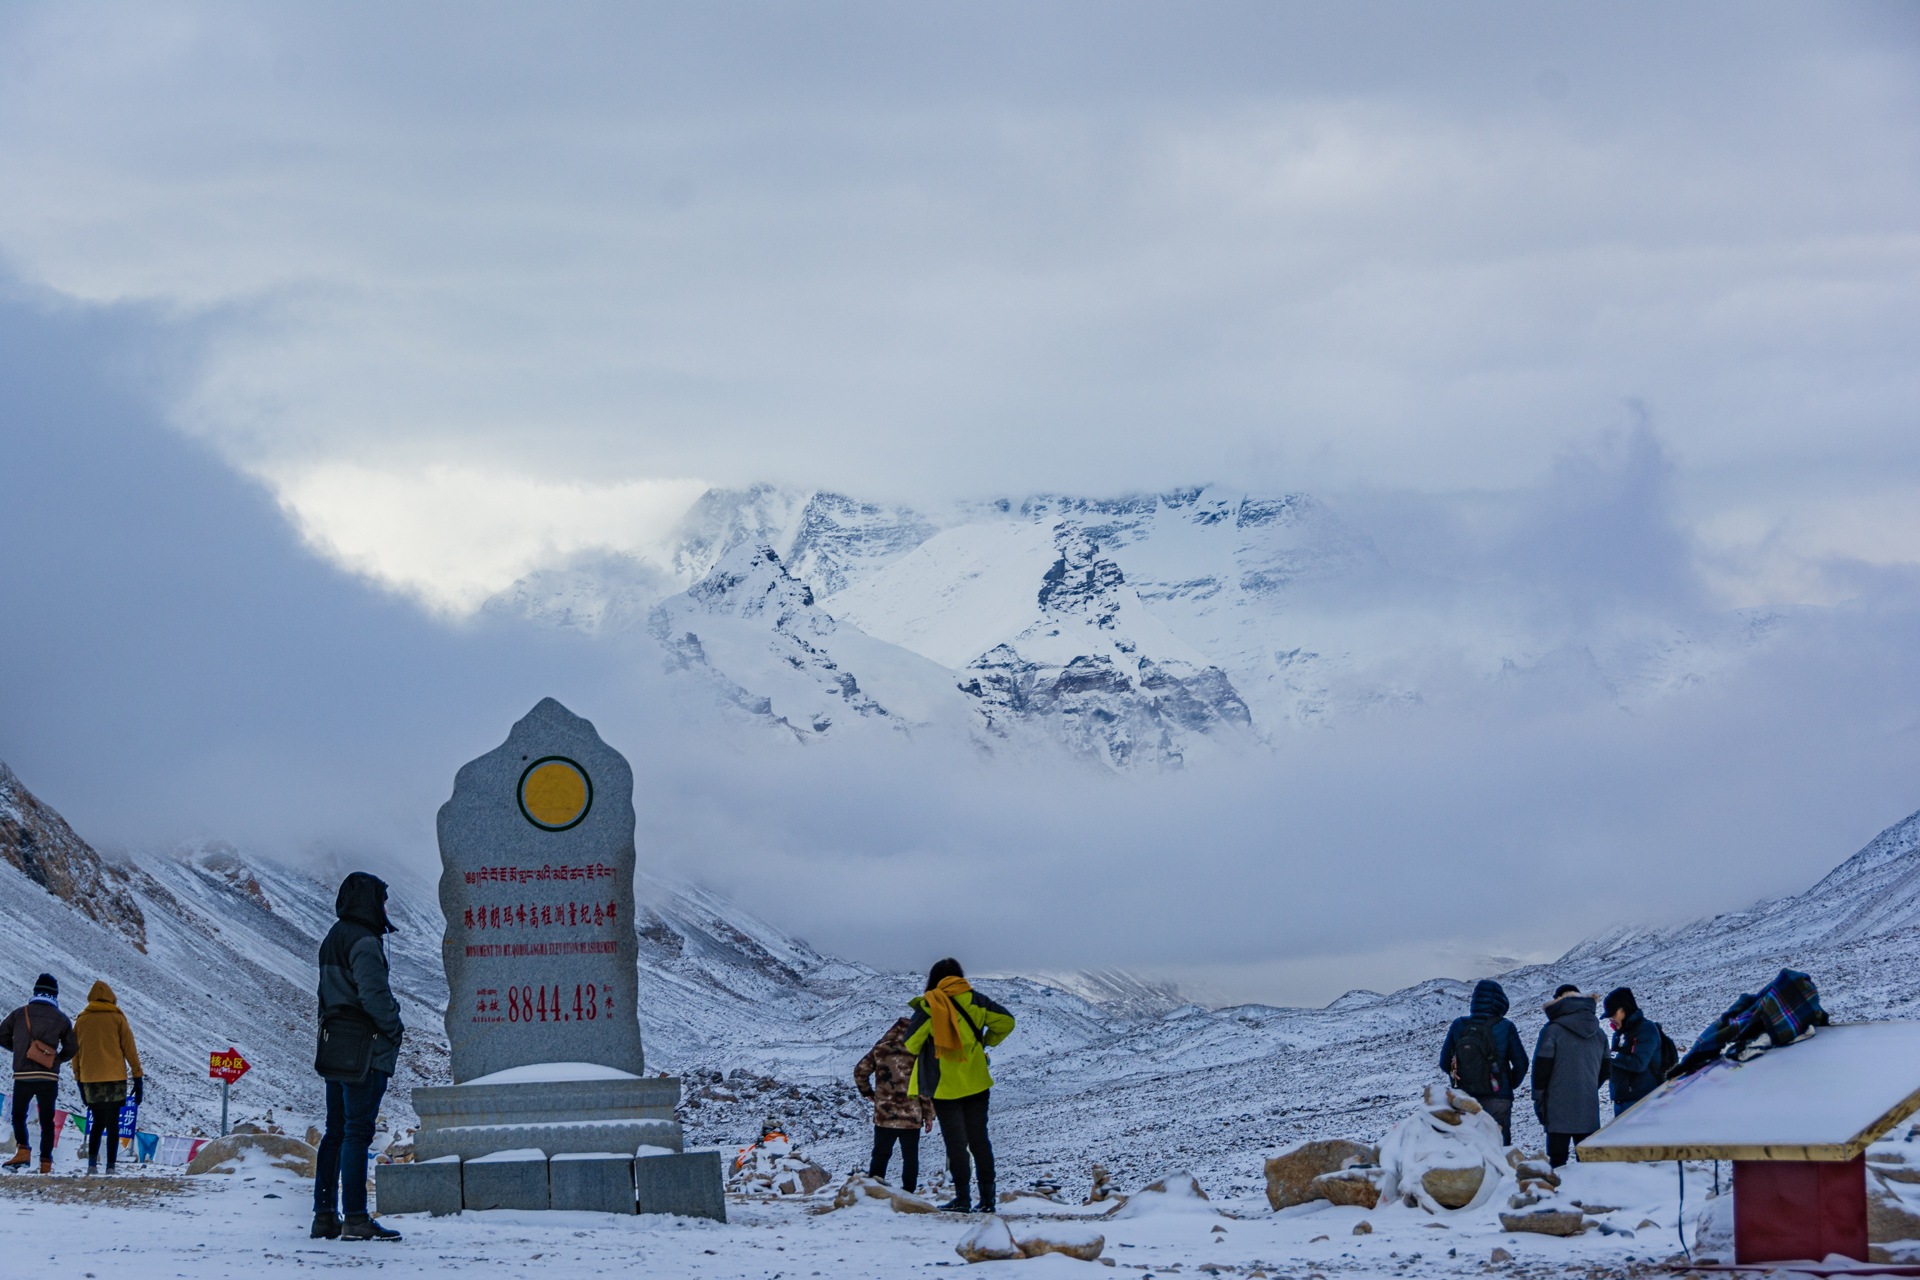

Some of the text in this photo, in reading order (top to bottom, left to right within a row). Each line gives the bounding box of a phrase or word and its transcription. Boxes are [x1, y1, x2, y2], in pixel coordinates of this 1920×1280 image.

[464, 899, 617, 930] 珠穆朗玛峰高程测量纪念碑
[465, 944, 493, 957] MONUMENT
[495, 944, 502, 956] TO
[549, 942, 578, 955] ELEVATION
[580, 941, 617, 954] MEASUREMENT
[476, 999, 501, 1012] 海拔
[508, 983, 597, 1023] 8844.43
[605, 996, 615, 1009] 米
[210, 1055, 244, 1069] 核心区
